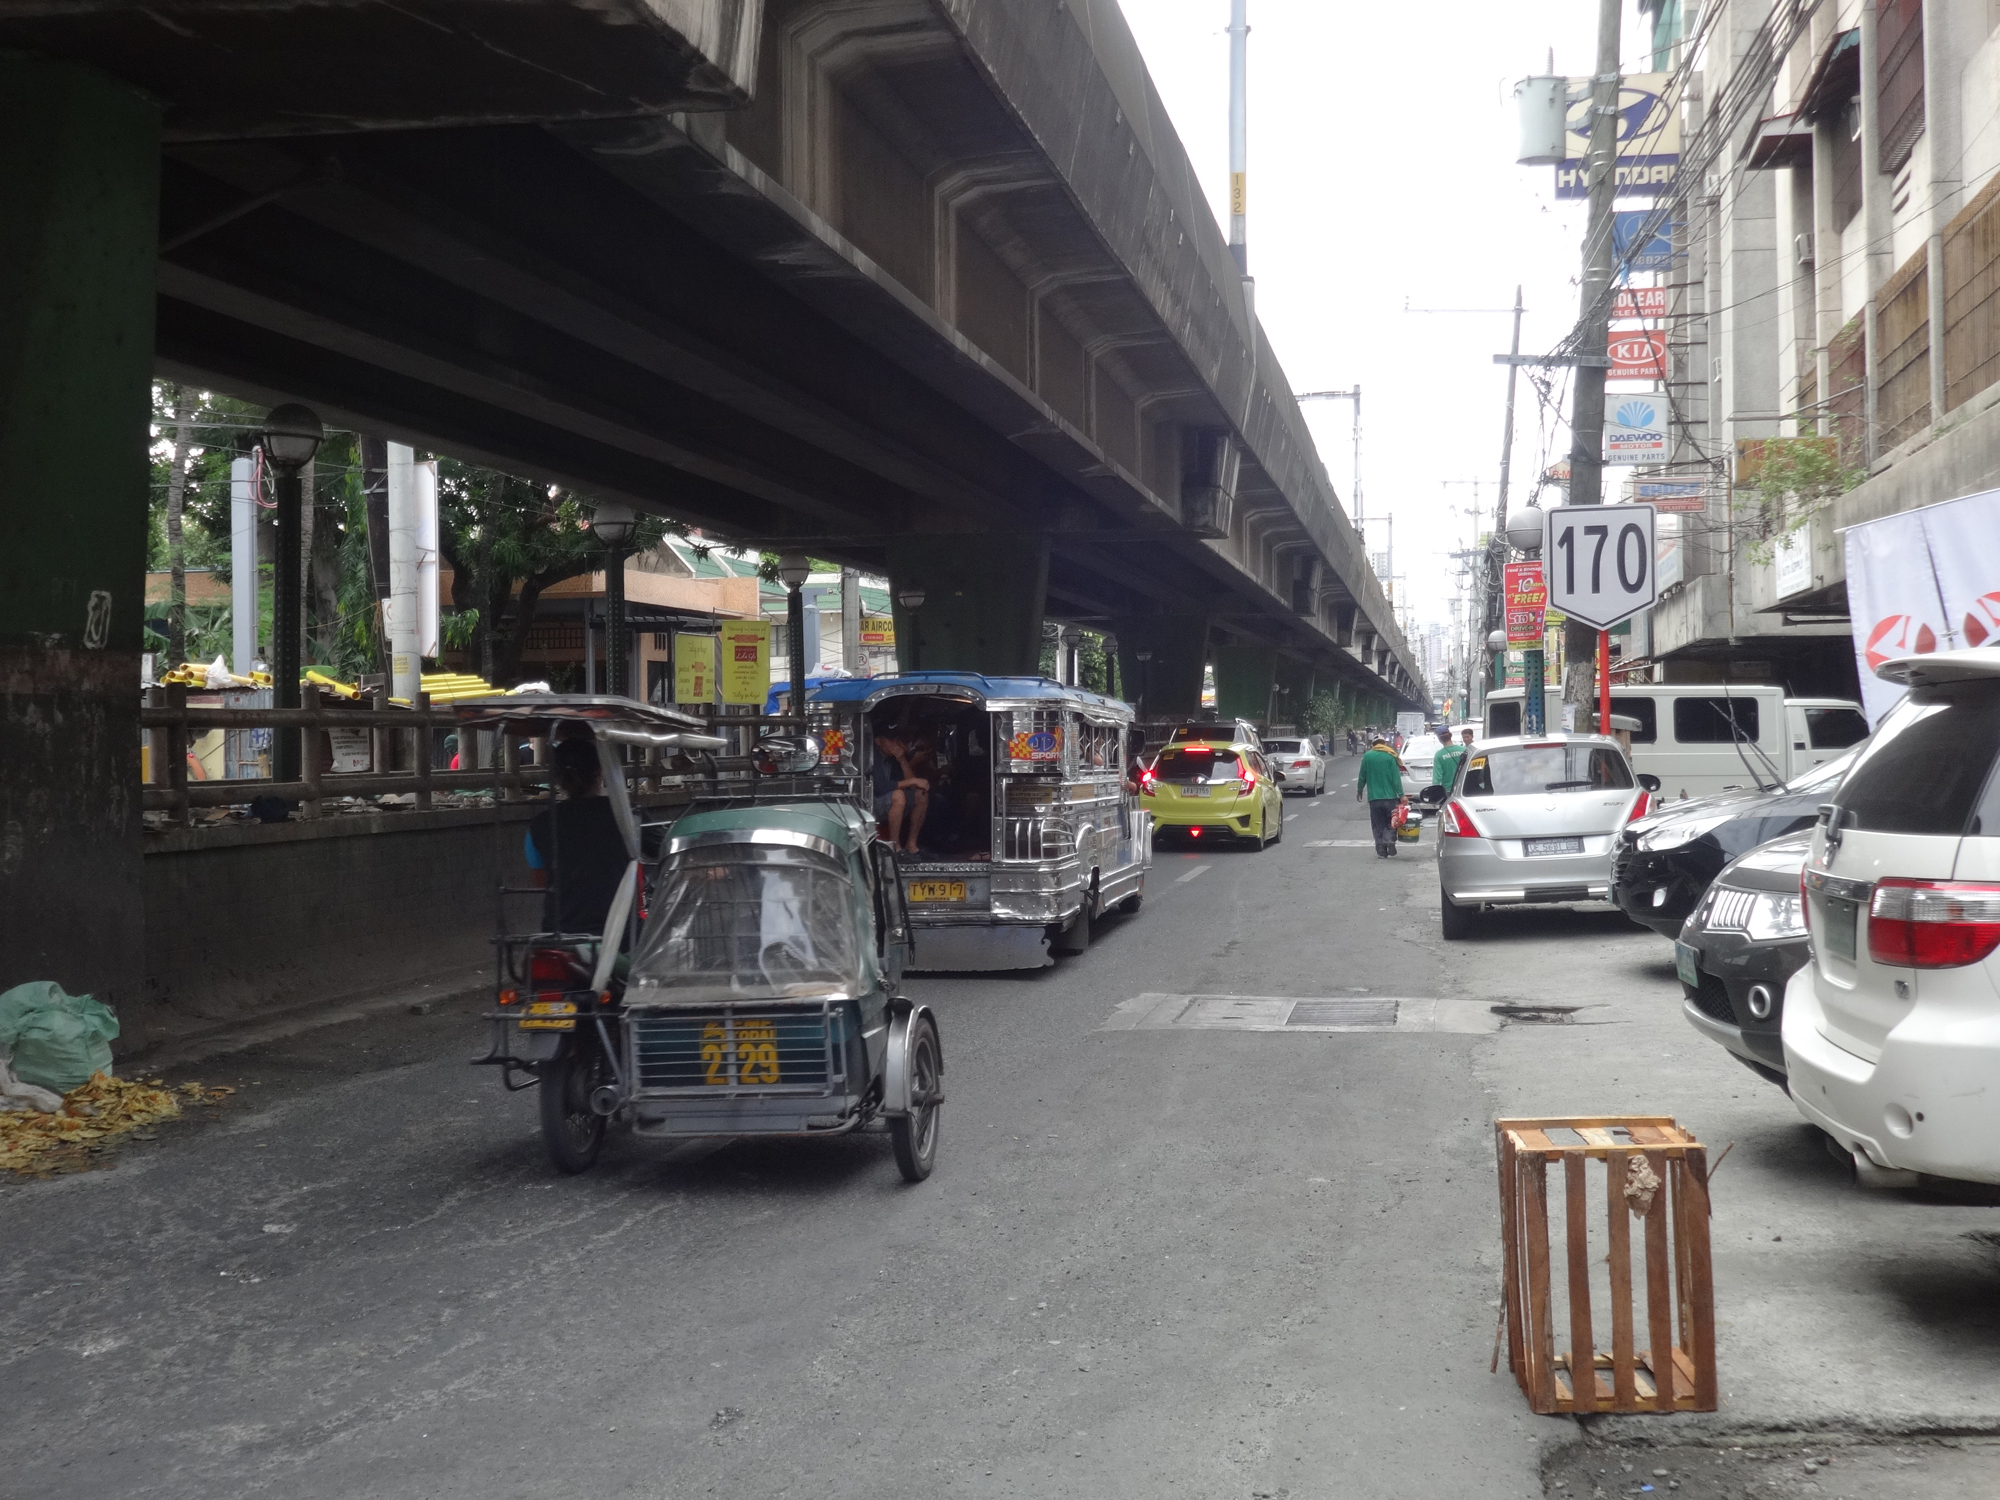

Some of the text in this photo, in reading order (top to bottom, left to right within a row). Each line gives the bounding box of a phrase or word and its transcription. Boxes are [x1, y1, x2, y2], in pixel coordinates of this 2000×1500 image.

[1558, 165, 1677, 188] HYNDAI
[1233, 174, 1242, 213] 132
[1617, 343, 1654, 359] KIA
[1607, 366, 1663, 376] GENUINE PART
[1609, 433, 1662, 443] DAEWOO
[1608, 453, 1638, 461] GENUINE
[1557, 523, 1647, 595] 170
[1514, 592, 1545, 604] FREE!
[702, 1042, 779, 1086] 229
